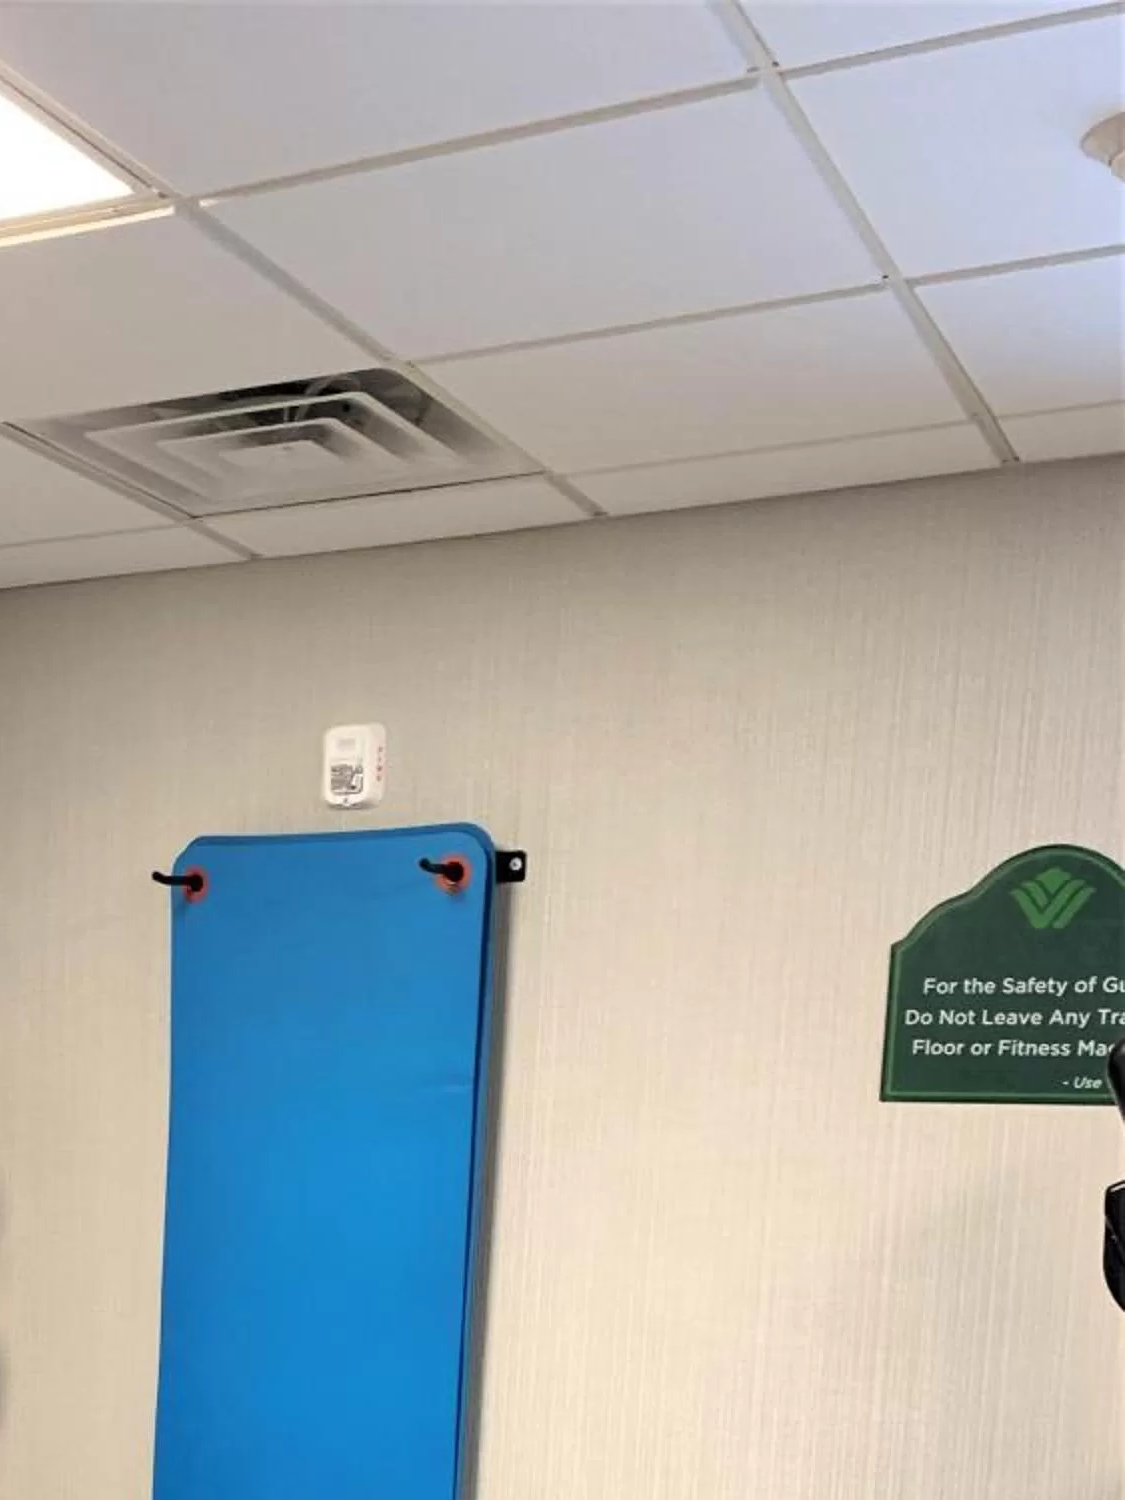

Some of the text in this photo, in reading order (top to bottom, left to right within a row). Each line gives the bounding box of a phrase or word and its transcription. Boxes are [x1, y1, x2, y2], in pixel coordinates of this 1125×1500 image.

[923, 977, 957, 994] For
[964, 978, 996, 994] the
[1002, 977, 1068, 997] Safety
[1074, 976, 1098, 993] of
[904, 1009, 933, 1026] Do
[939, 1009, 976, 1025] Not
[982, 1010, 1043, 1025] Leave
[1049, 1009, 1091, 1029] Any
[912, 1039, 964, 1056] Floor
[970, 1044, 991, 1057] or
[997, 1039, 1072, 1057] Fitness
[1073, 1076, 1103, 1089] Use
